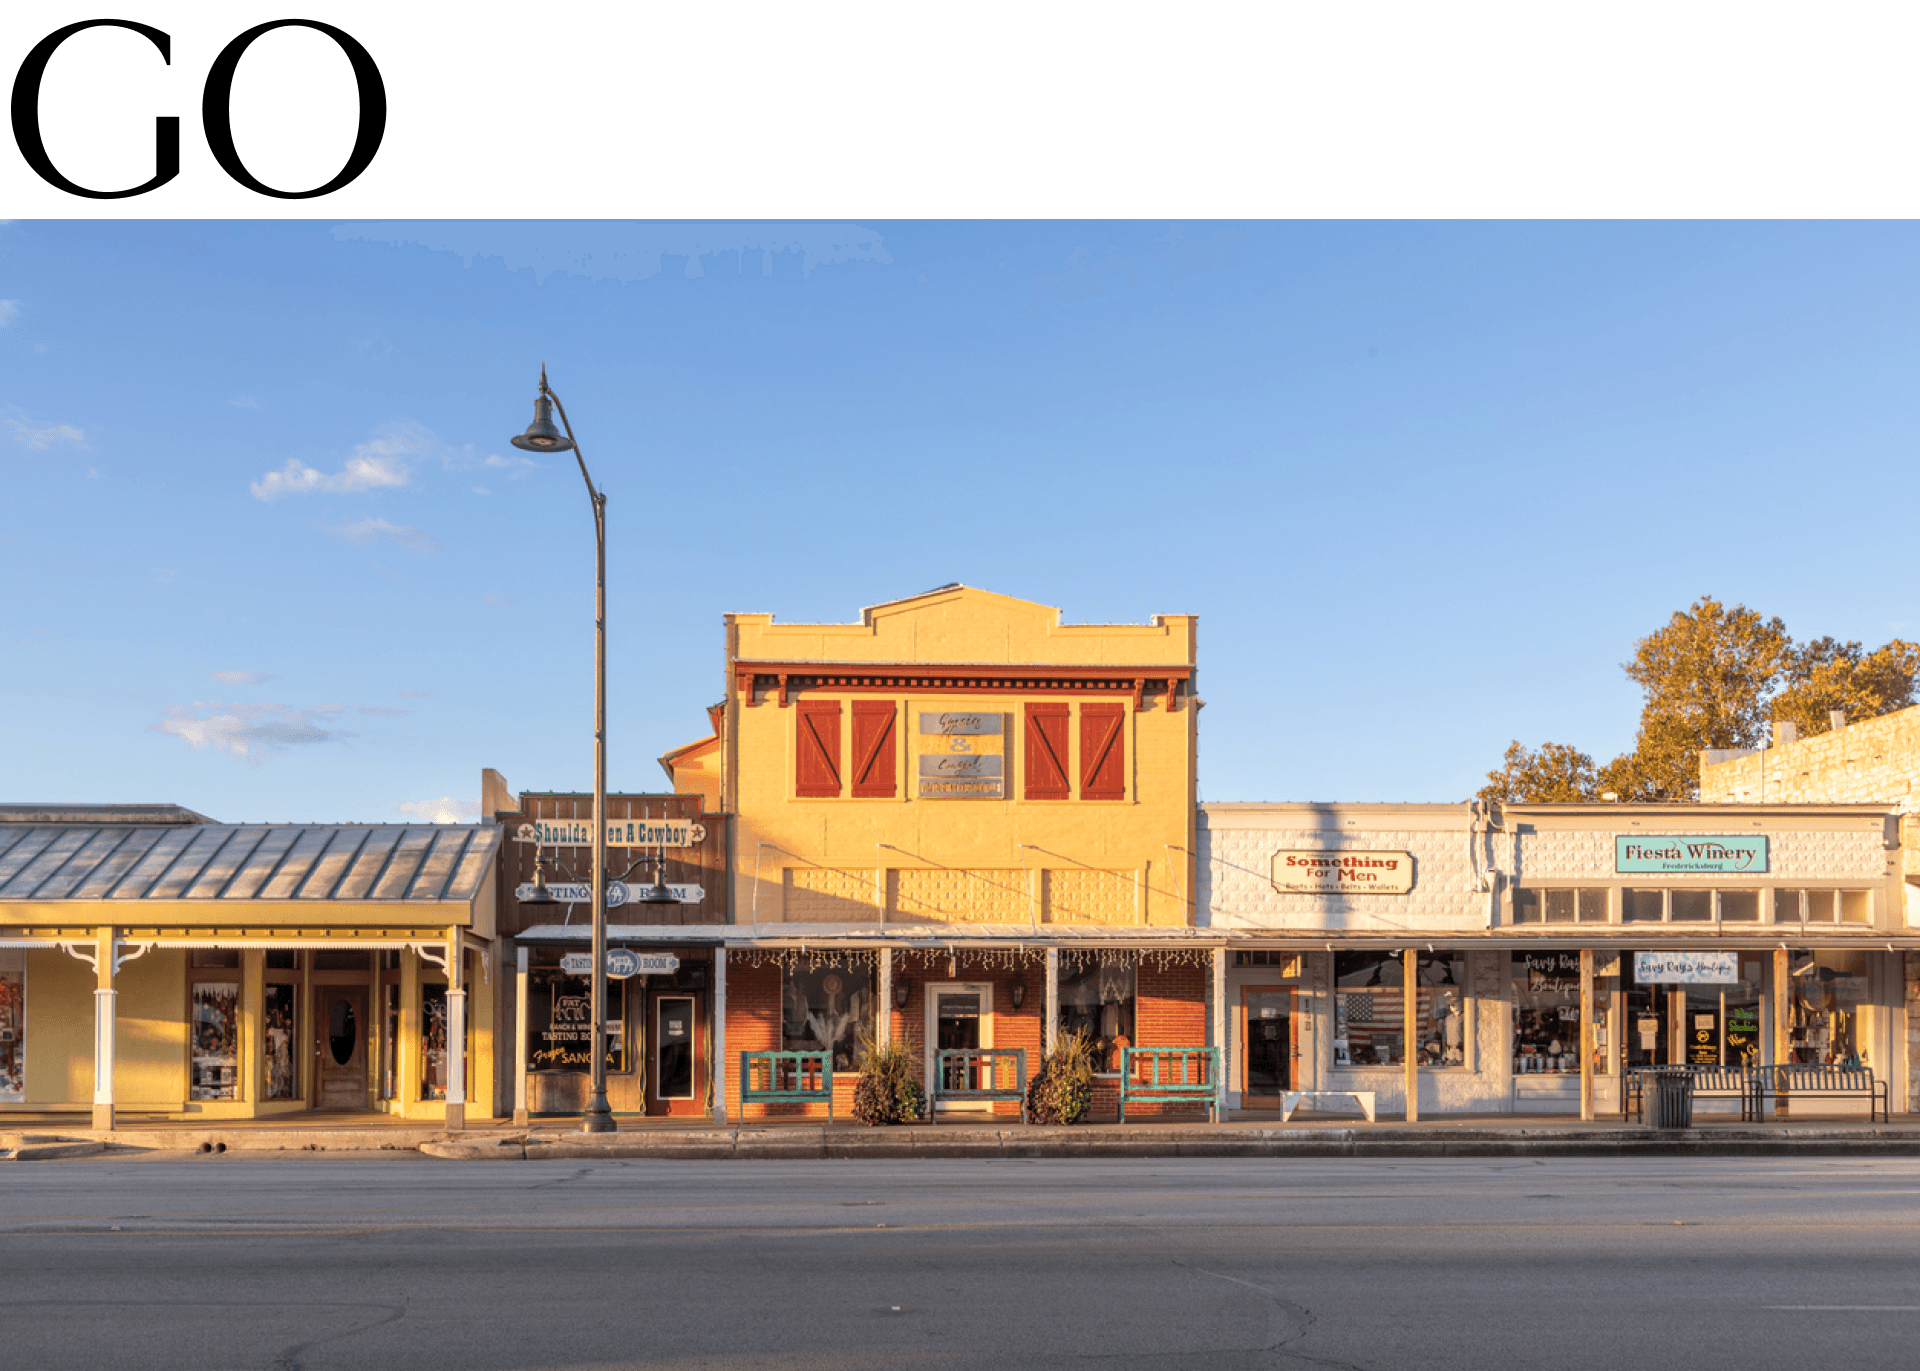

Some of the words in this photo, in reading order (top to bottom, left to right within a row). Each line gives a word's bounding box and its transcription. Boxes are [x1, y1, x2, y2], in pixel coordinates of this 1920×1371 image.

[950, 737, 971, 752] &
[536, 824, 587, 843] Shoulda
[626, 824, 634, 842] A
[639, 824, 686, 846] Cowboy
[1625, 841, 1682, 860] Fiesta
[1680, 839, 1757, 870] Winery
[1286, 856, 1398, 870] Something
[1306, 869, 1331, 878] For
[1338, 869, 1377, 881] Men
[1369, 882, 1398, 890] Wallets
[640, 888, 686, 899] RM
[643, 958, 666, 968] ROOM
[542, 1032, 577, 1041] TASTING
